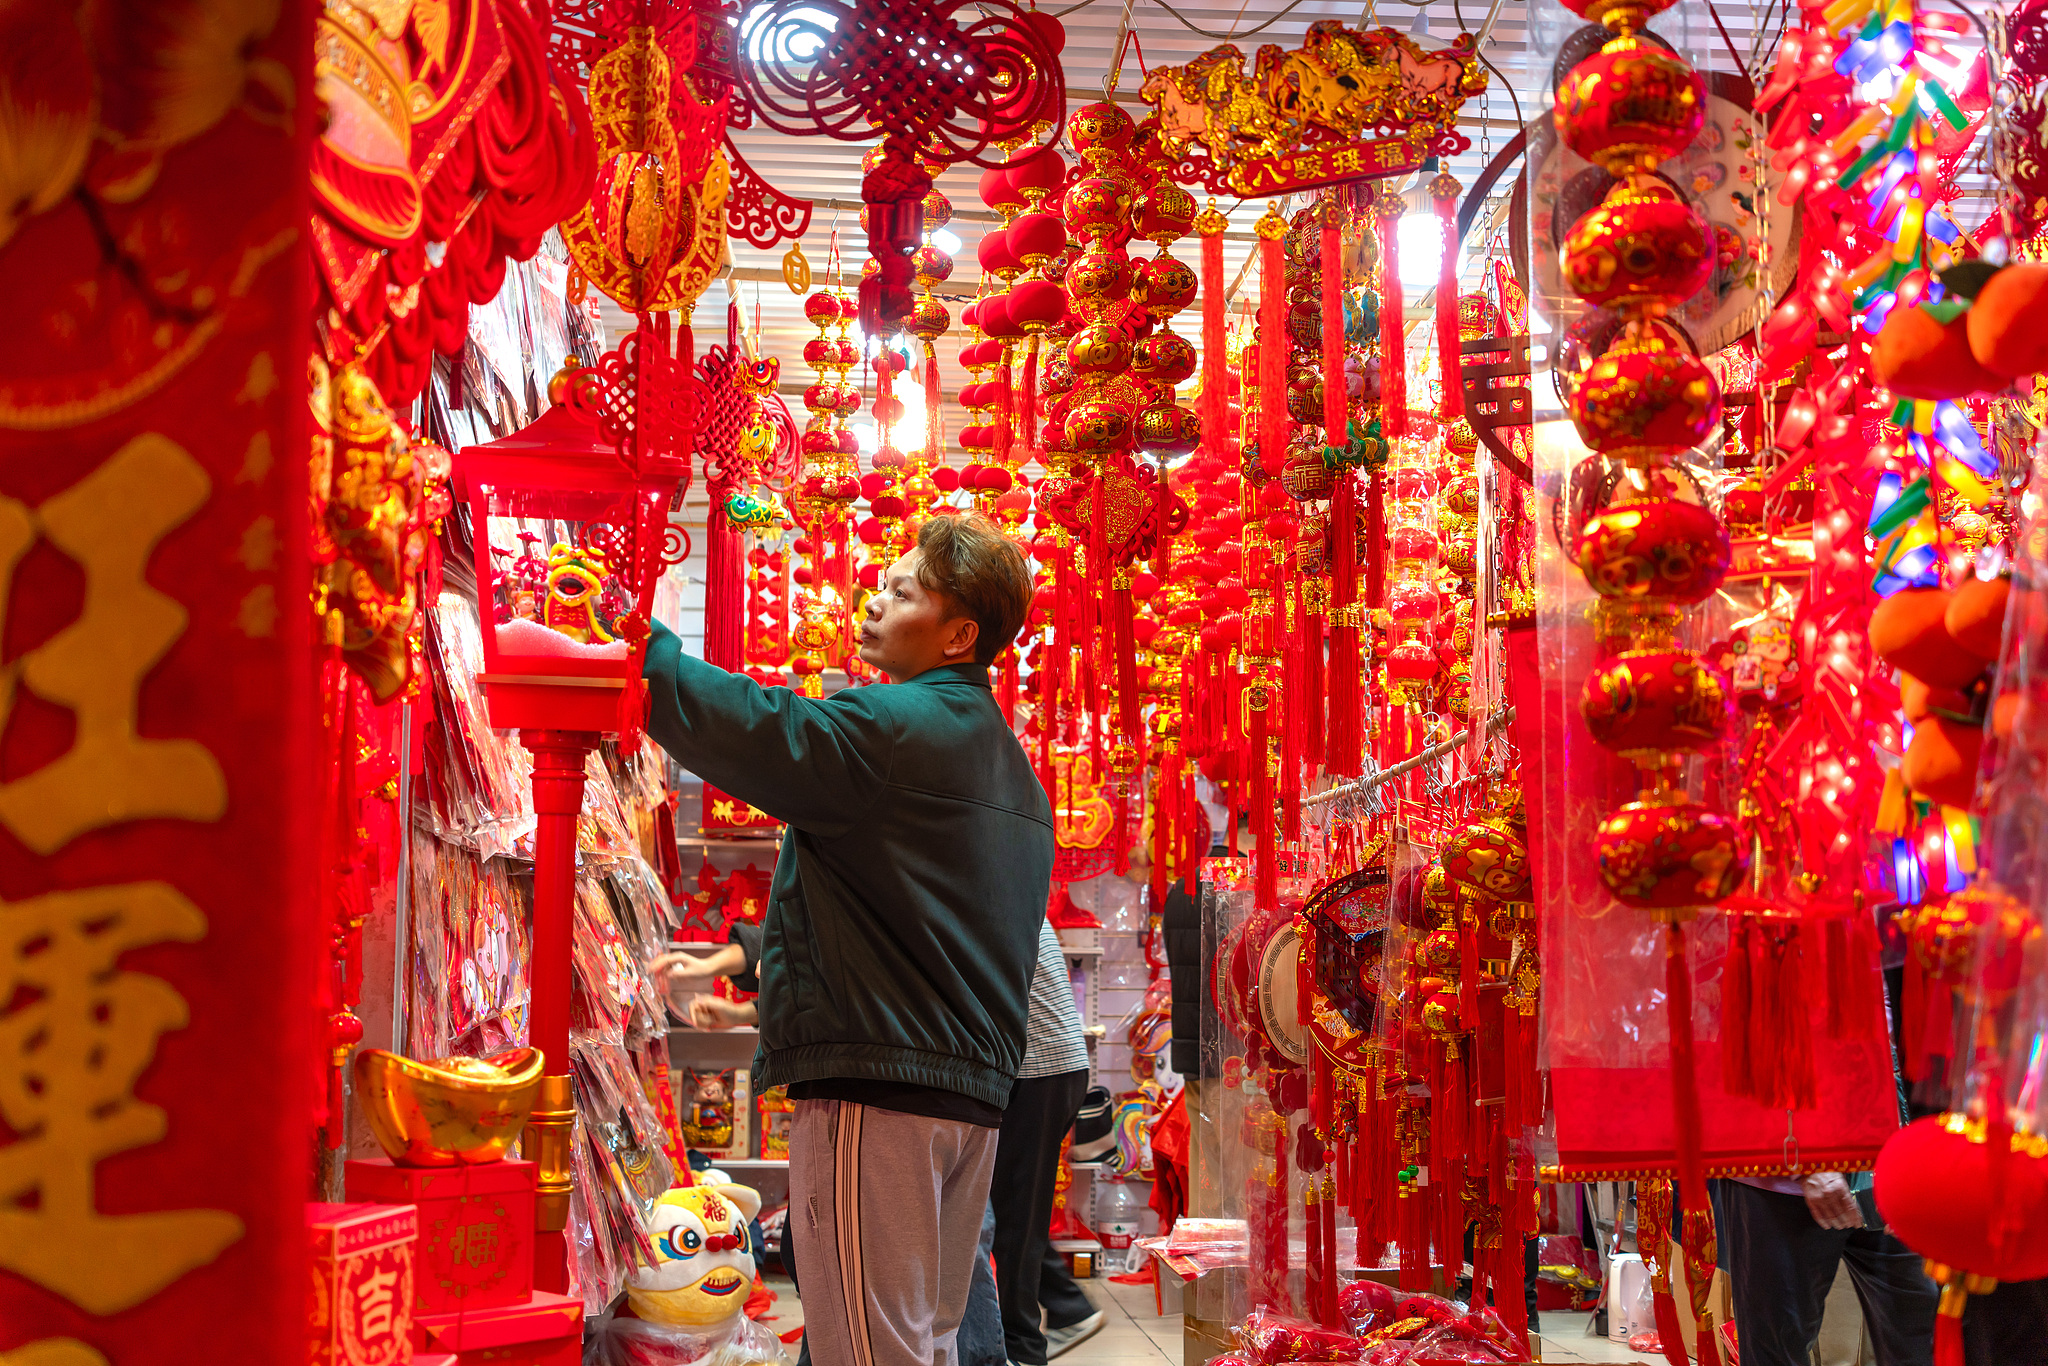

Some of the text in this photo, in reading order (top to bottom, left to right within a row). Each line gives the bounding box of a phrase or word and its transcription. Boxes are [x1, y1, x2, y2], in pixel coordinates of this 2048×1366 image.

[1252, 142, 1407, 188] 八駿接福
[1073, 327, 1118, 367] 福
[1294, 463, 1325, 492] 福
[702, 1193, 727, 1222] 福
[357, 1266, 397, 1341] 吉
